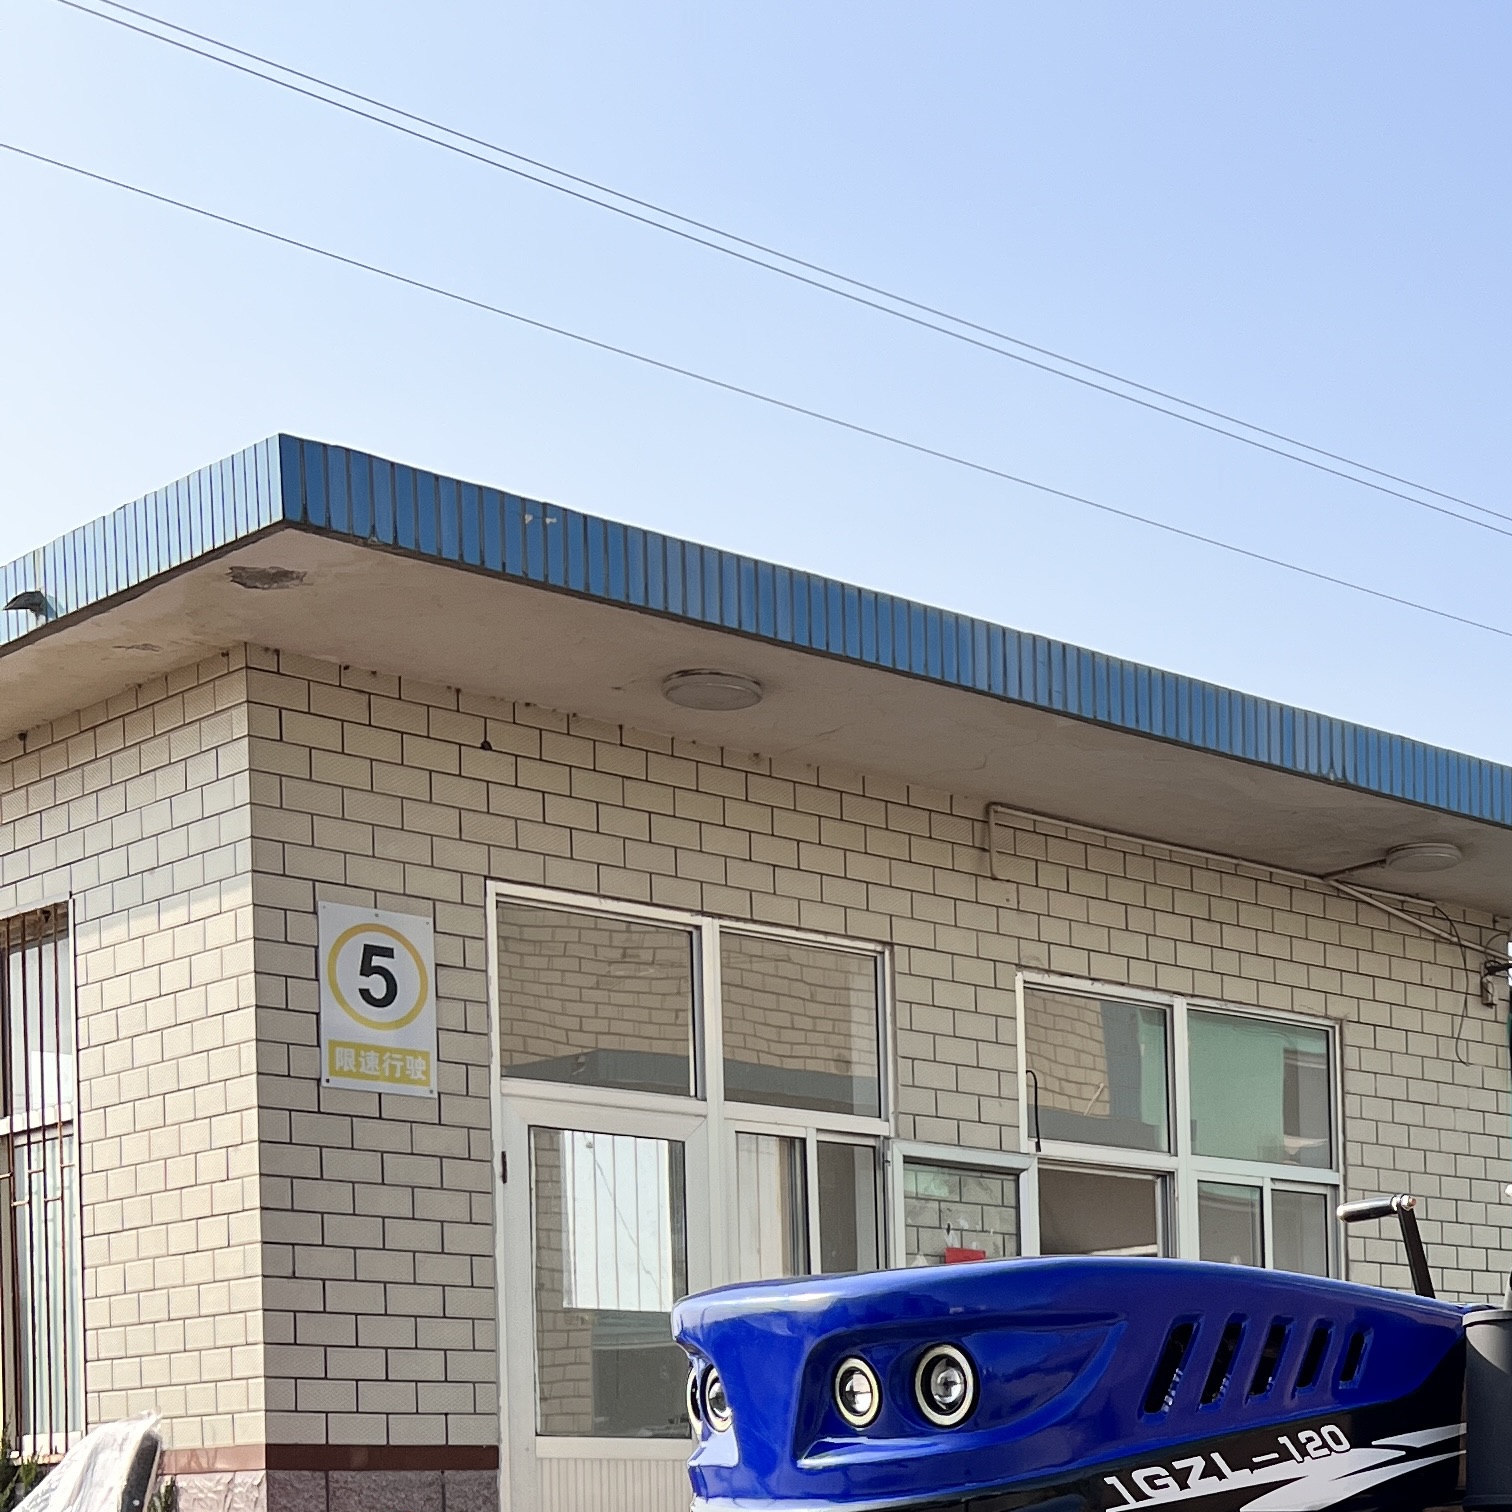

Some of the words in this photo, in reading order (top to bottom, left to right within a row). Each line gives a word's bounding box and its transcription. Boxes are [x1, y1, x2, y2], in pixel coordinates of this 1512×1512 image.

[358, 943, 398, 1009] 5
[335, 1046, 427, 1081] 限速行驶
[1103, 1424, 1351, 1505] 1GZL-120
